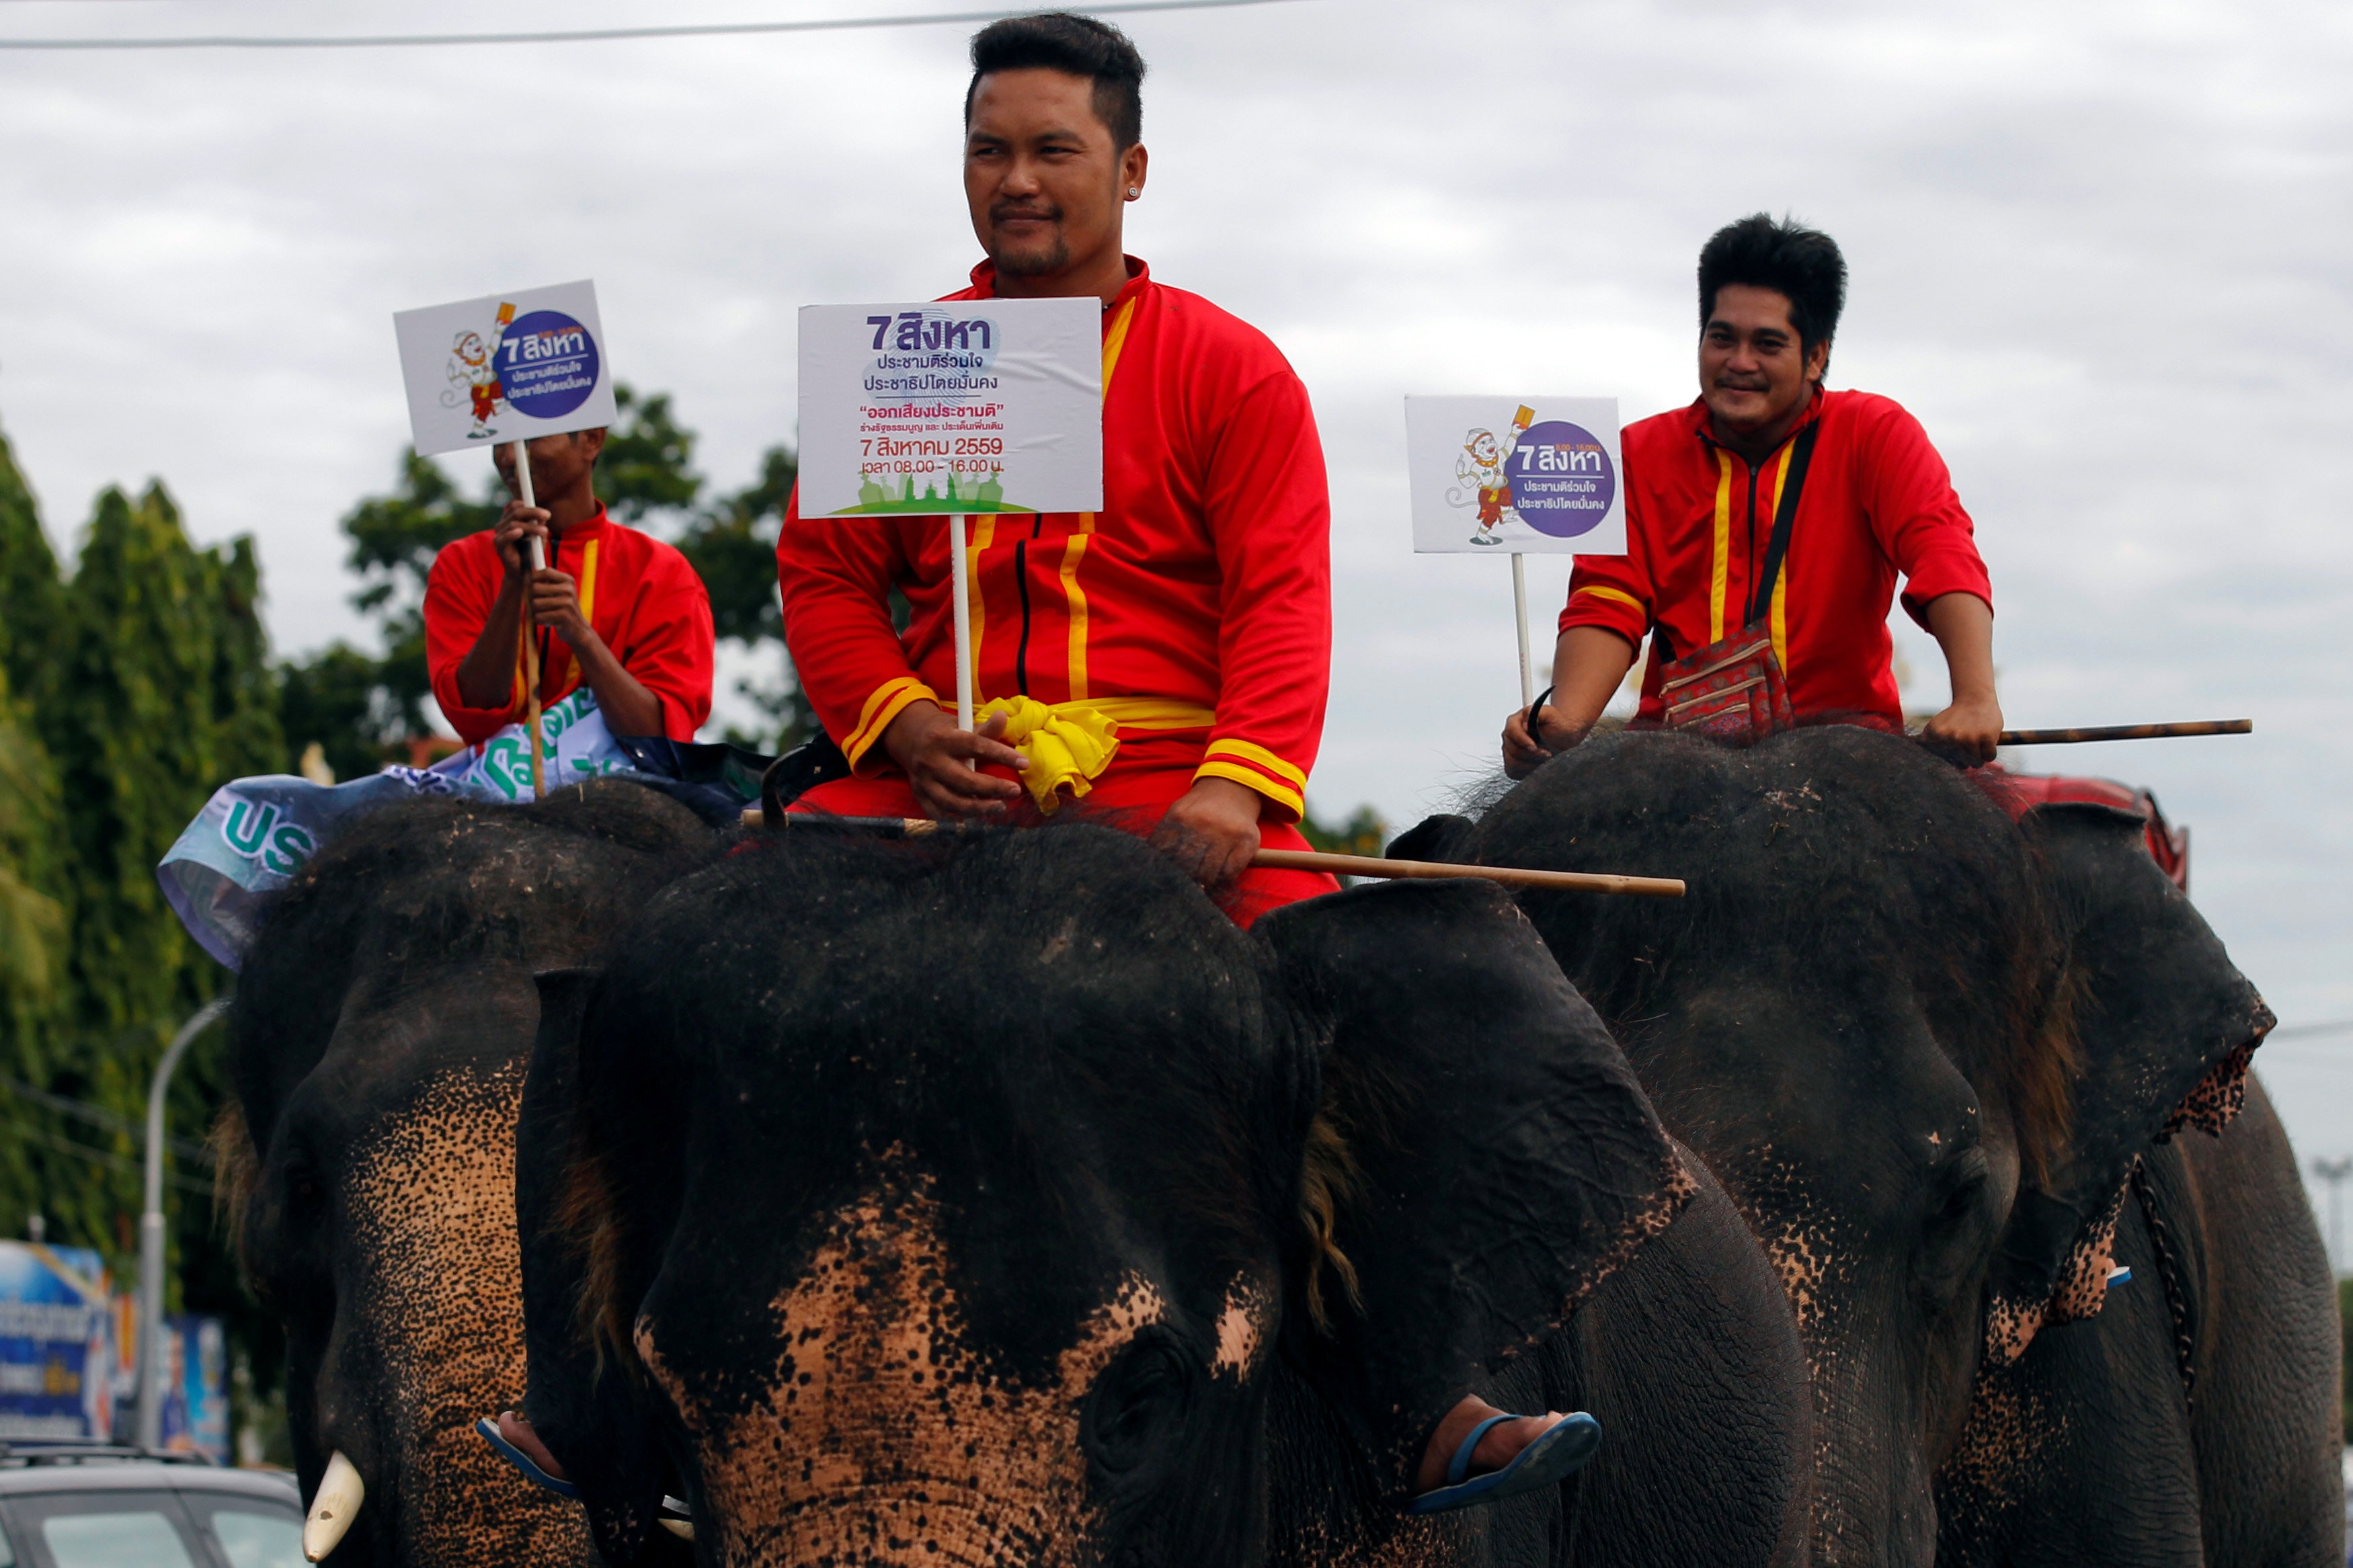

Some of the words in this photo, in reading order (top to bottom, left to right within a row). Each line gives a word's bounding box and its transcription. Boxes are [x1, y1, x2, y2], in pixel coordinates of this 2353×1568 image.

[867, 315, 892, 350] 7
[897, 313, 991, 351] สิงหา
[501, 337, 520, 364] 7
[877, 352, 984, 369] ประชามติร่วมใจ
[864, 371, 998, 390] ประชาธิปไตยมั่นคง
[925, 423, 939, 431] และ
[860, 438, 873, 457] 7
[877, 437, 950, 456] สิงหาคม
[954, 438, 1003, 456] 2559
[861, 461, 891, 474] เวลา
[893, 460, 934, 473] 08.00
[949, 460, 988, 472] 16.00
[1517, 445, 1535, 470] 7
[1538, 445, 1602, 471] สิงหา
